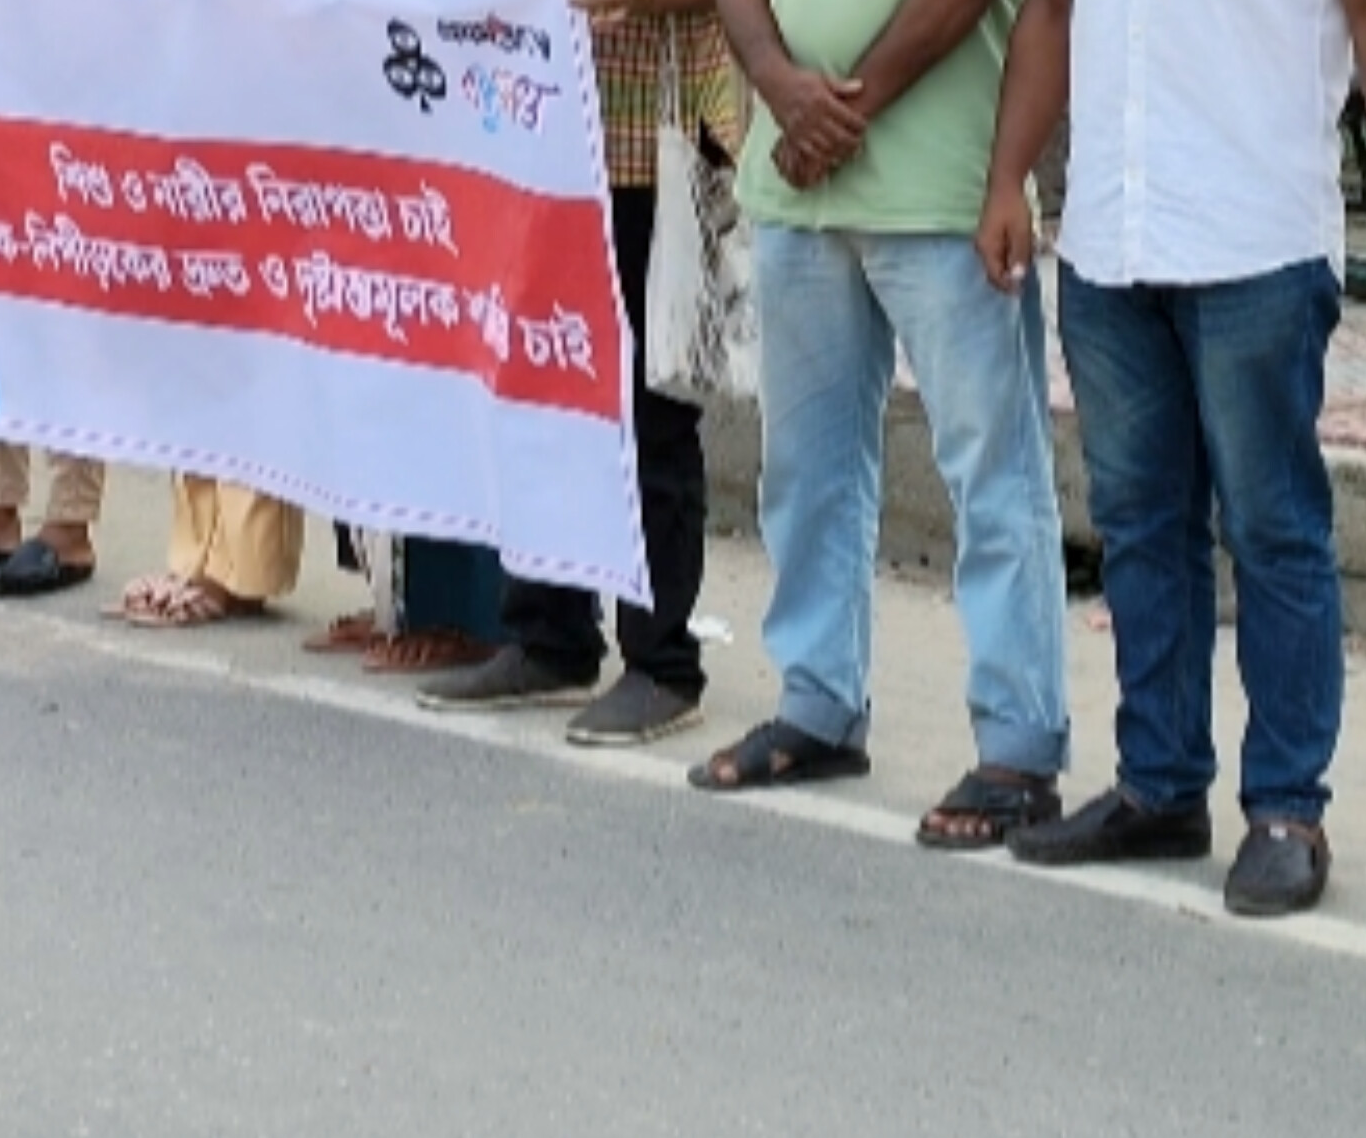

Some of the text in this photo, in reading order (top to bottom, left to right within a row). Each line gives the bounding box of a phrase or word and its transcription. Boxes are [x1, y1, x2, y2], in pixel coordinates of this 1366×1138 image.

[50, 141, 114, 209] শিশু
[121, 170, 146, 213] ও
[394, 178, 460, 259] চাই
[259, 253, 288, 299] ও
[516, 299, 598, 380] চাই
